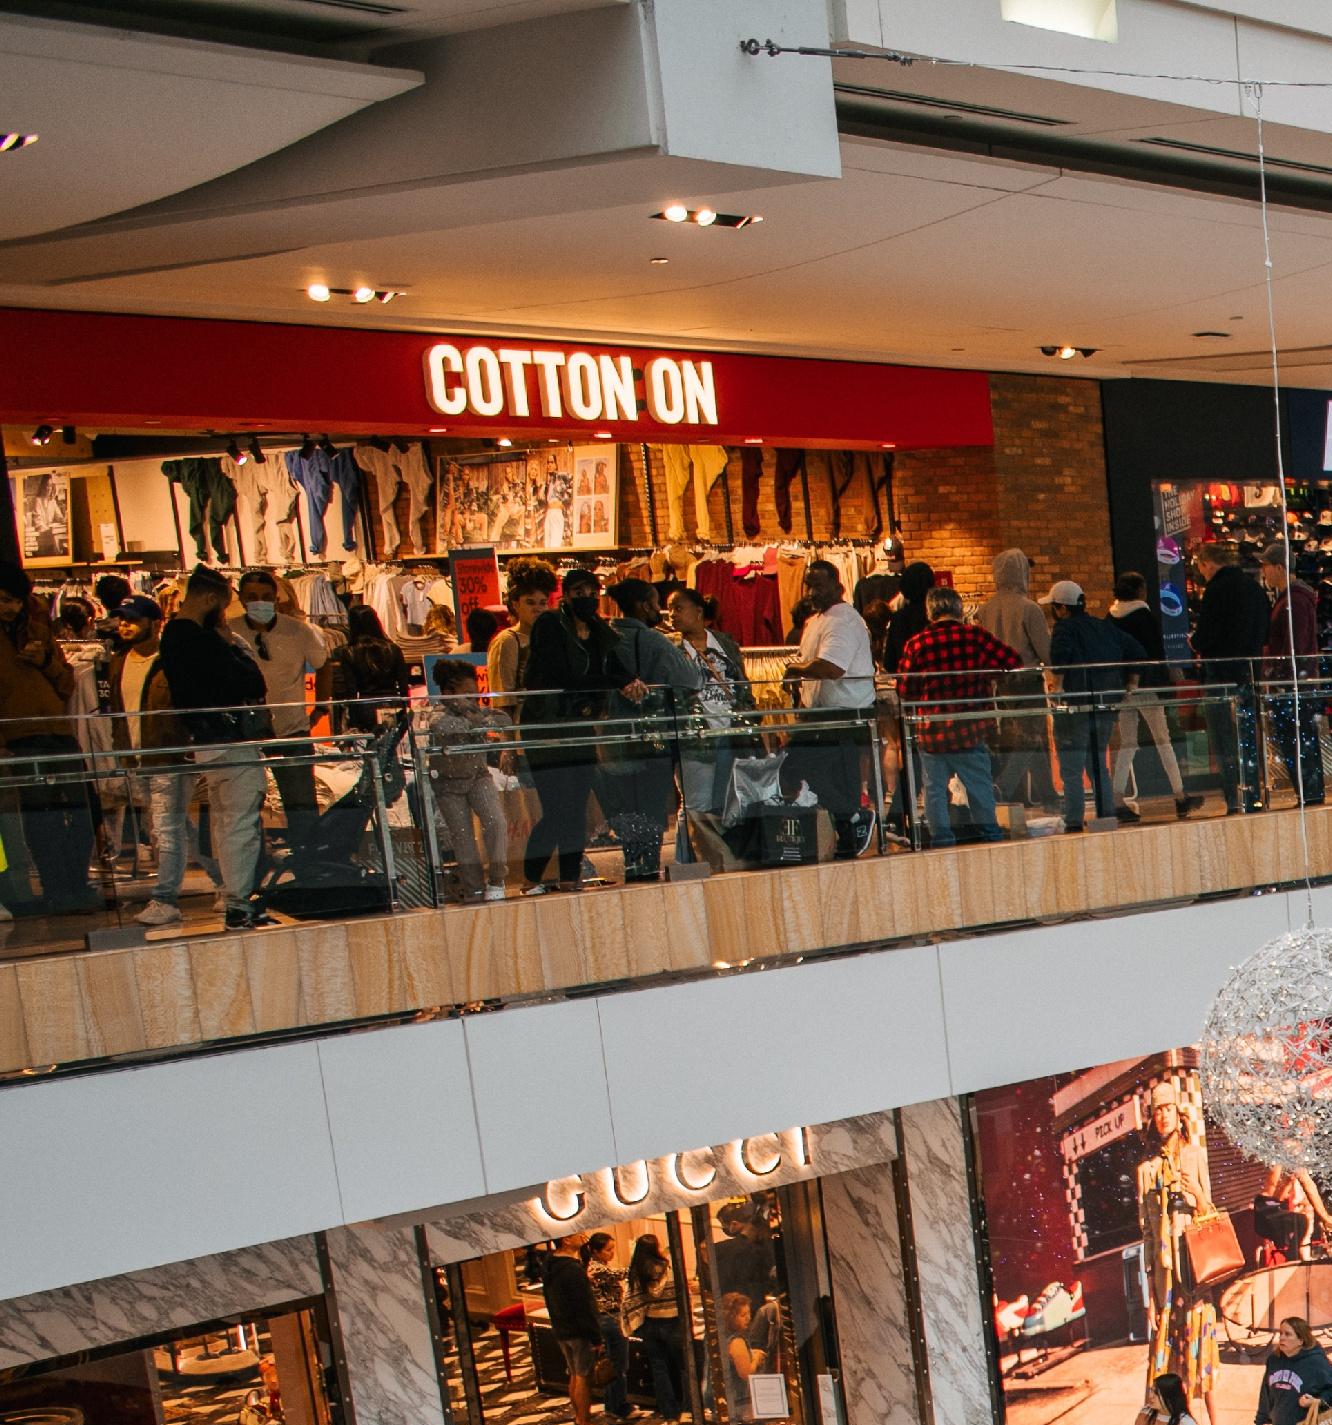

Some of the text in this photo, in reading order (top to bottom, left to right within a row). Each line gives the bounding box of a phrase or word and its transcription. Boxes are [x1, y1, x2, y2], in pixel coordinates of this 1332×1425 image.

[424, 344, 718, 424] COTTON ON
[1167, 514, 1191, 533] INSIDE
[459, 575, 488, 594] 30%
[1095, 1113, 1124, 1138] PICK UP
[537, 1126, 811, 1221] GUCCI
